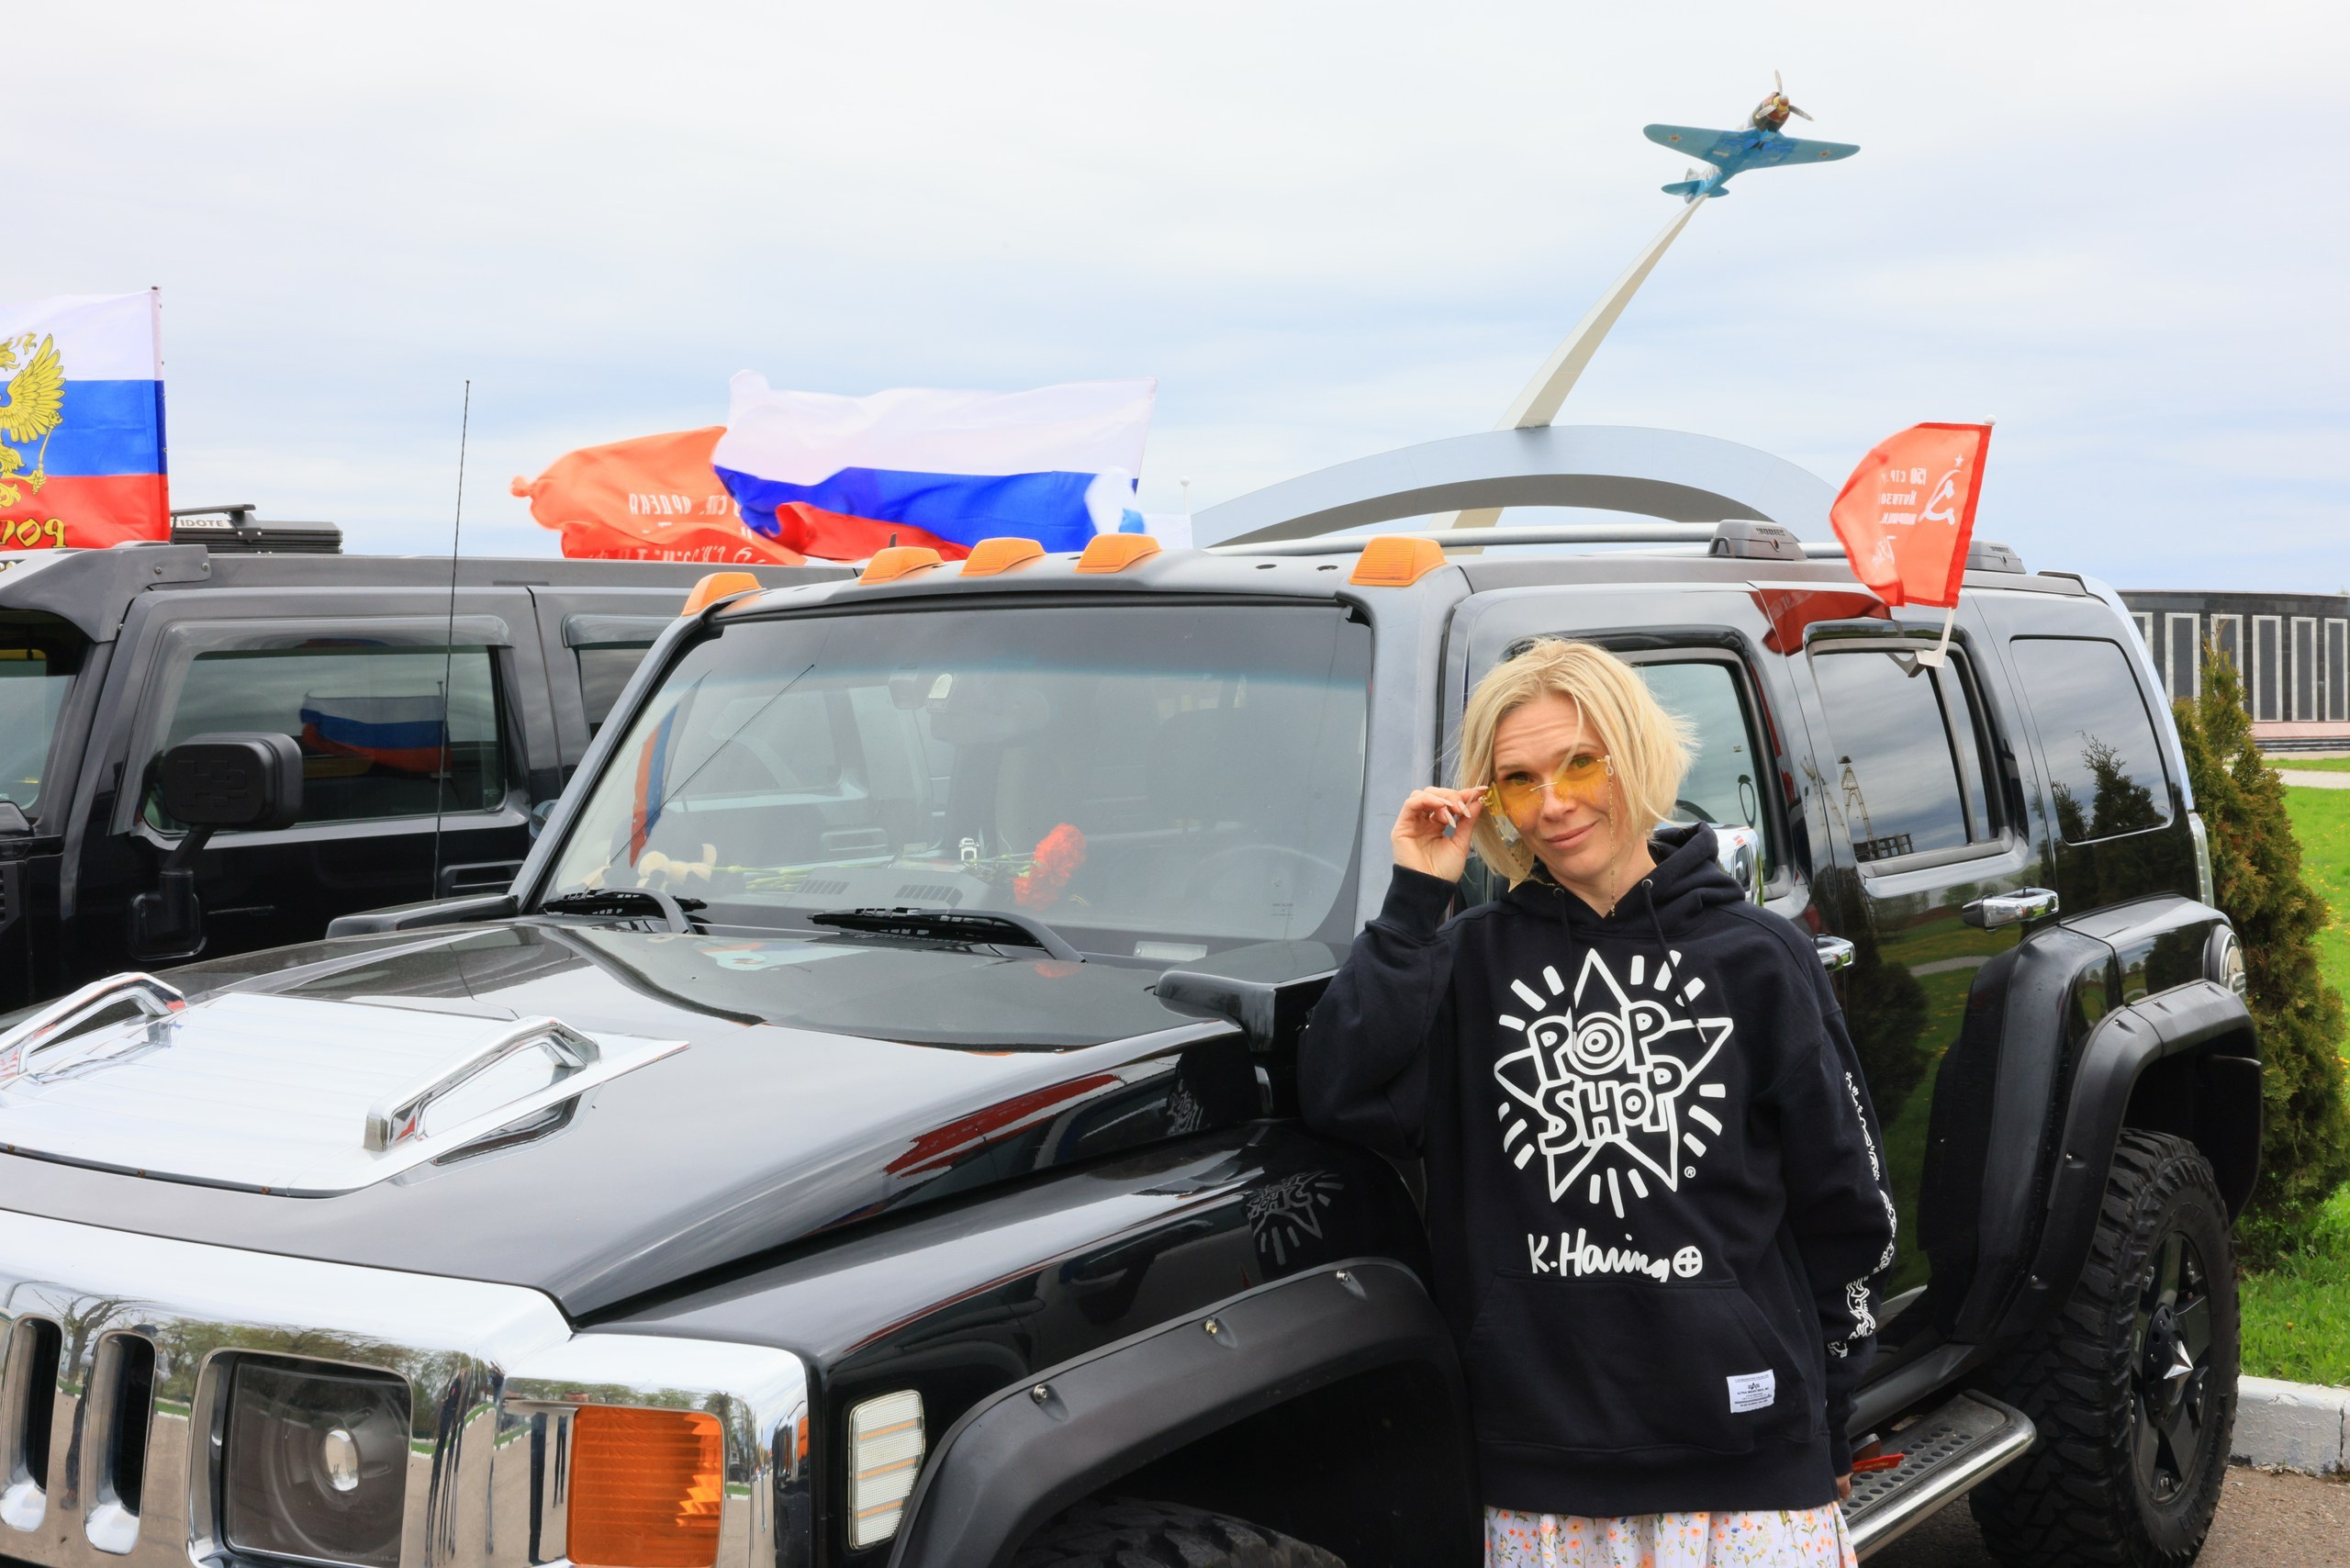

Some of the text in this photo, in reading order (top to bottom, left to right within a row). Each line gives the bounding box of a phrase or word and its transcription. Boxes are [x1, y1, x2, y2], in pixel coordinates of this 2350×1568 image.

[173, 519, 225, 527] IDOTE
[1528, 1000, 1672, 1084] POP
[1536, 1055, 1688, 1155] SHOP
